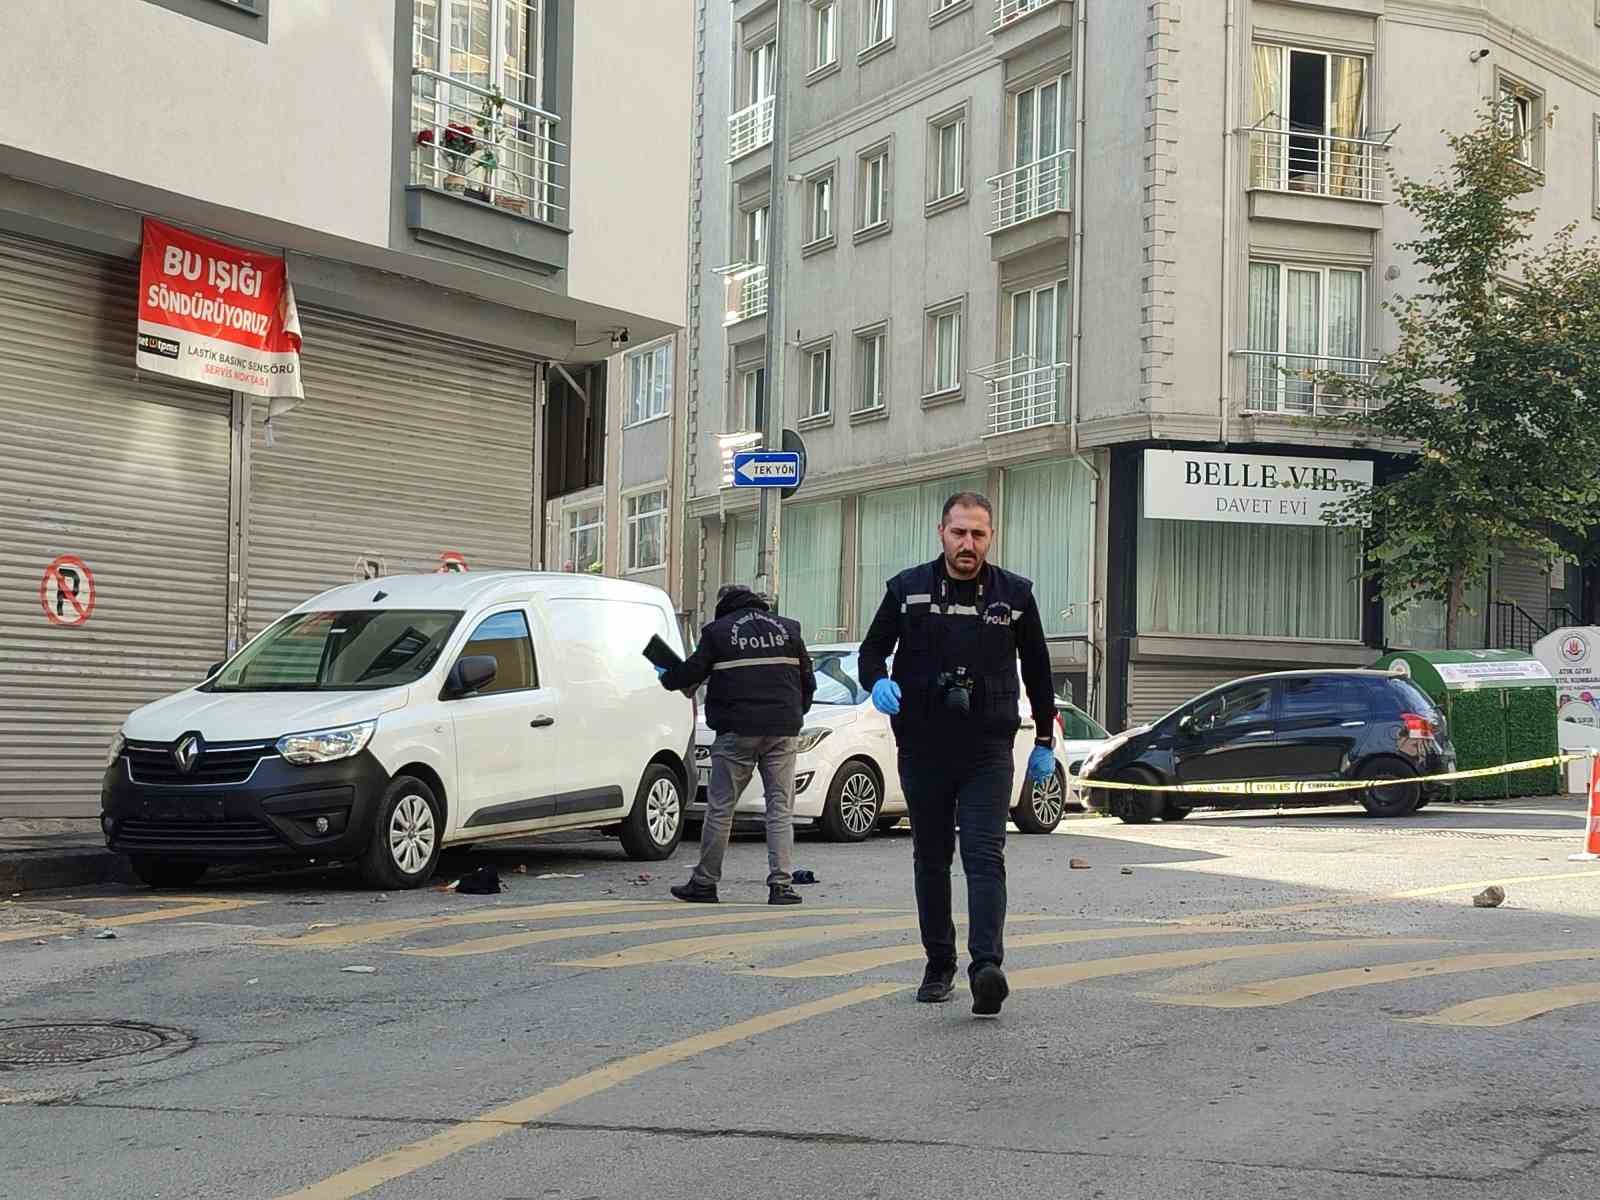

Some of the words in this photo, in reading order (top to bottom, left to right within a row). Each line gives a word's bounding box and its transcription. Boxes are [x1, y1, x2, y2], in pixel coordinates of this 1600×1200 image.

[163, 244, 202, 281] BU
[207, 257, 264, 299] IŞIĞI
[147, 283, 269, 336] SÖNDÜRÜYORUZ
[754, 465, 772, 475] TEK
[775, 463, 795, 475] YÖN
[1185, 460, 1278, 489] BELLE
[1287, 466, 1338, 493] VIE
[1216, 497, 1273, 514] DAVET
[1279, 497, 1309, 516] EVİ
